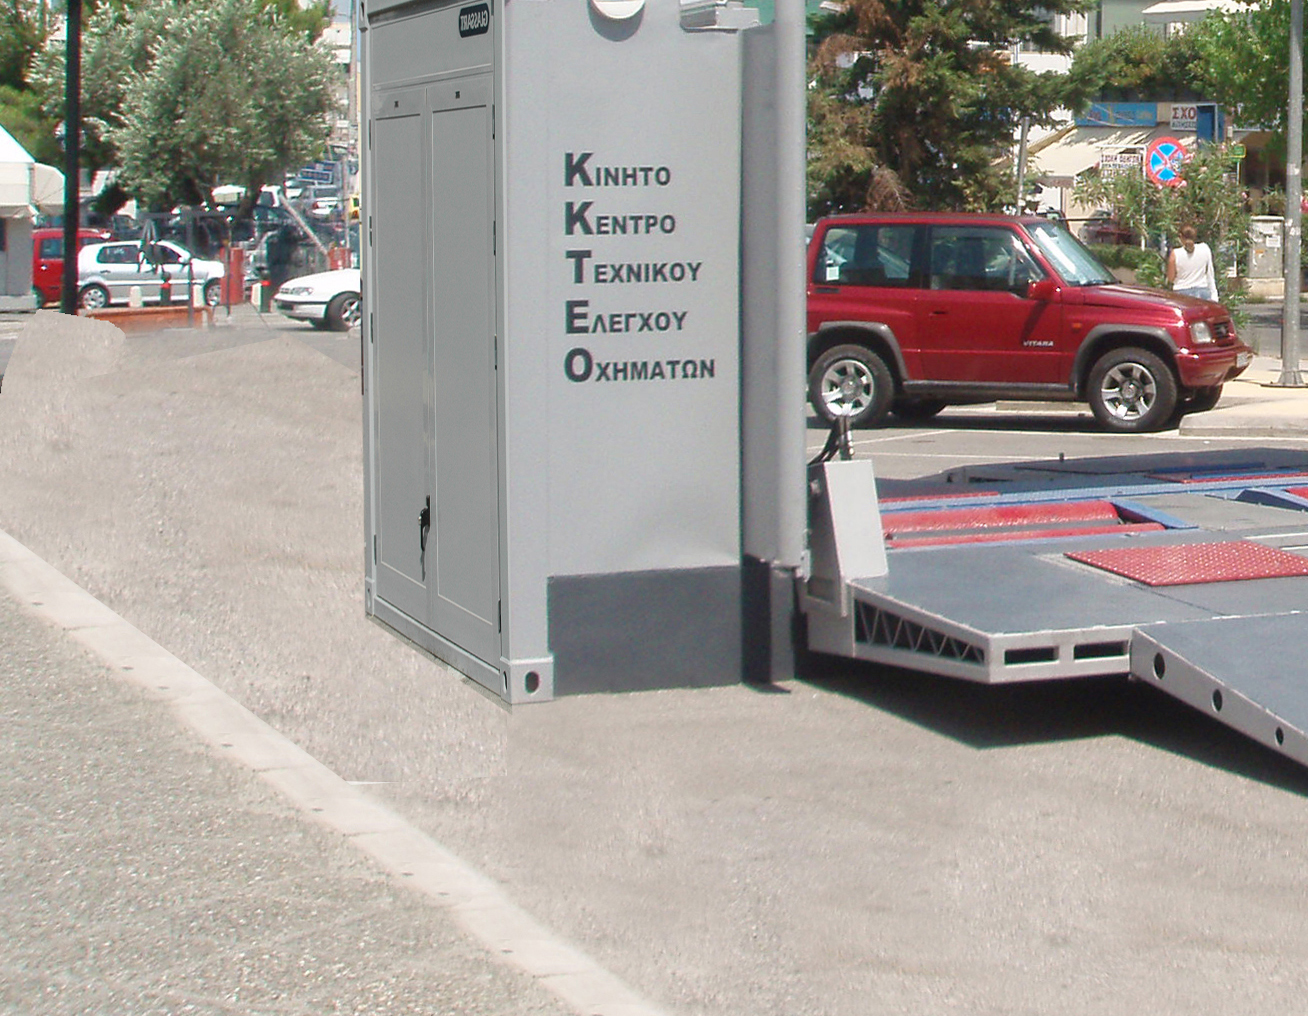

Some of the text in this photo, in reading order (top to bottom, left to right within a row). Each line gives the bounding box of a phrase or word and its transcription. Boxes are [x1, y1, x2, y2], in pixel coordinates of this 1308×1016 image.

[563, 152, 671, 187] ΚΙΝΗΤΟ
[564, 201, 676, 236] ΚΕΝΤΡΟ
[564, 249, 702, 285] ΤΕΧΝΙΚΟΥ
[564, 299, 688, 335] ΕΛΕΓΧΟΥ
[563, 348, 716, 383] ΟΧΗΜΑΤΩΝ
